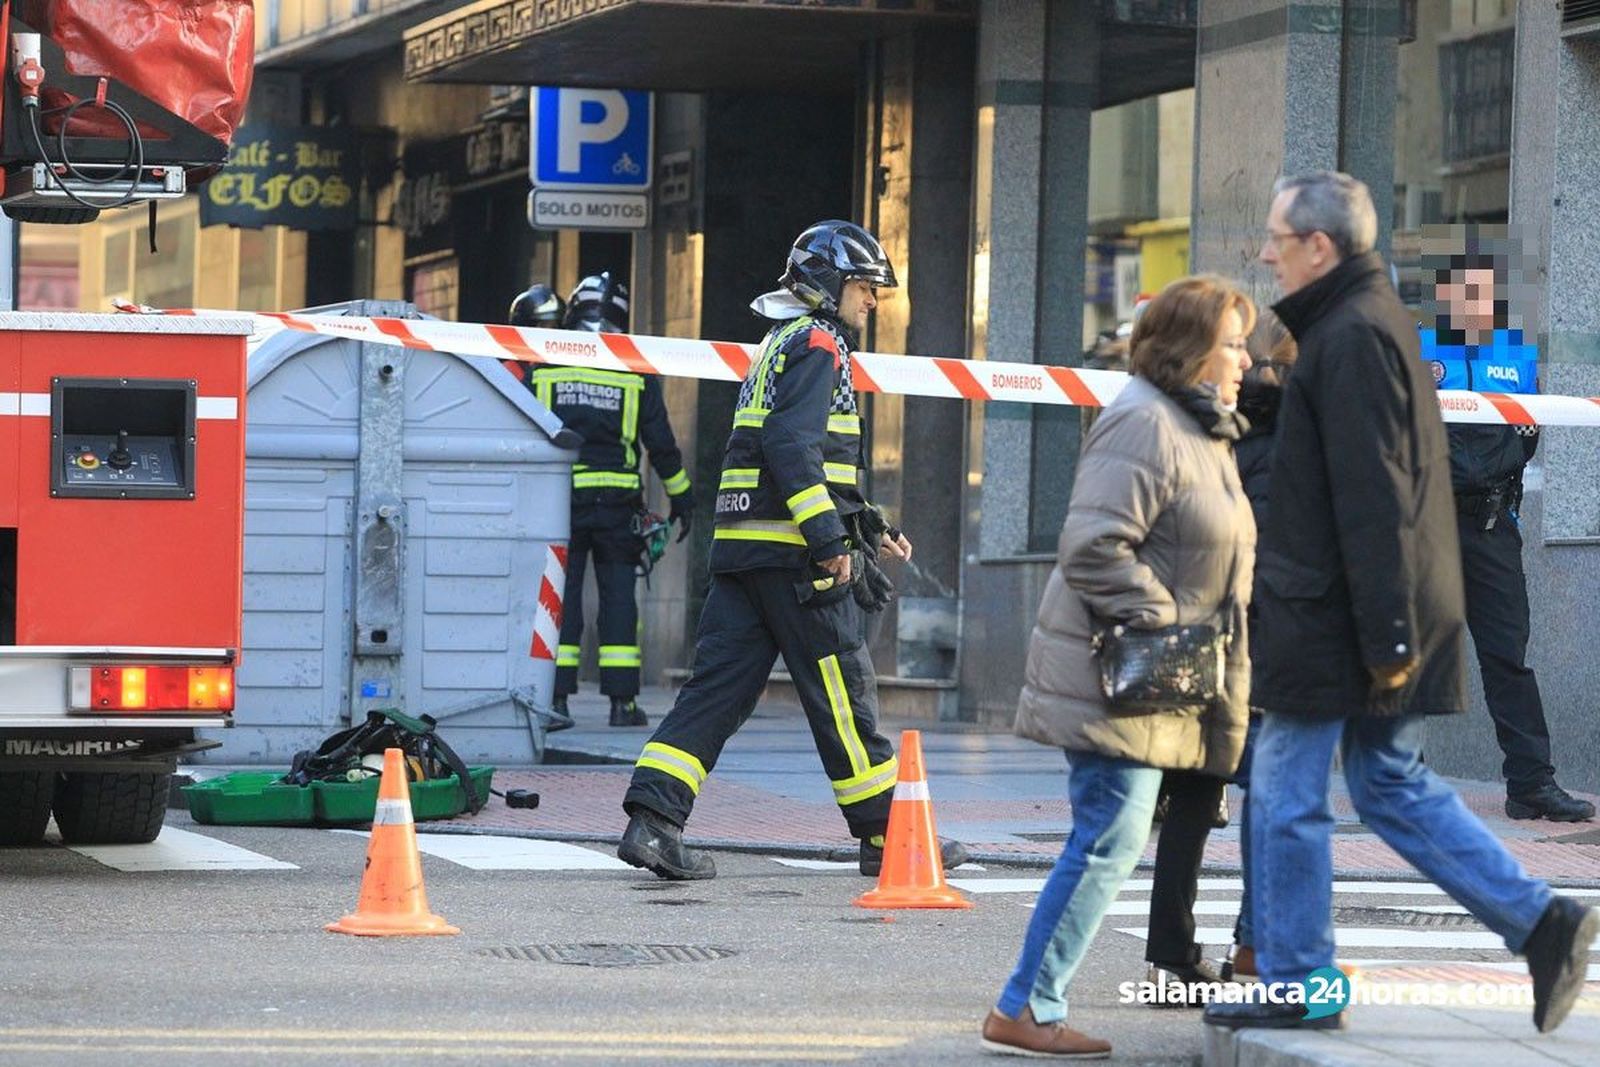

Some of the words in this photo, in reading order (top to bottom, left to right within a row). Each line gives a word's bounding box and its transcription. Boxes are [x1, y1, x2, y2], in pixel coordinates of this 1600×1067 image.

[557, 88, 630, 174] P
[295, 142, 343, 170] Bar
[208, 173, 351, 211] ELFOS
[538, 202, 582, 216] SOLO
[587, 204, 643, 218] MOTOS
[544, 340, 597, 357] BOMBEROS
[992, 374, 1042, 391] BOMBEROS
